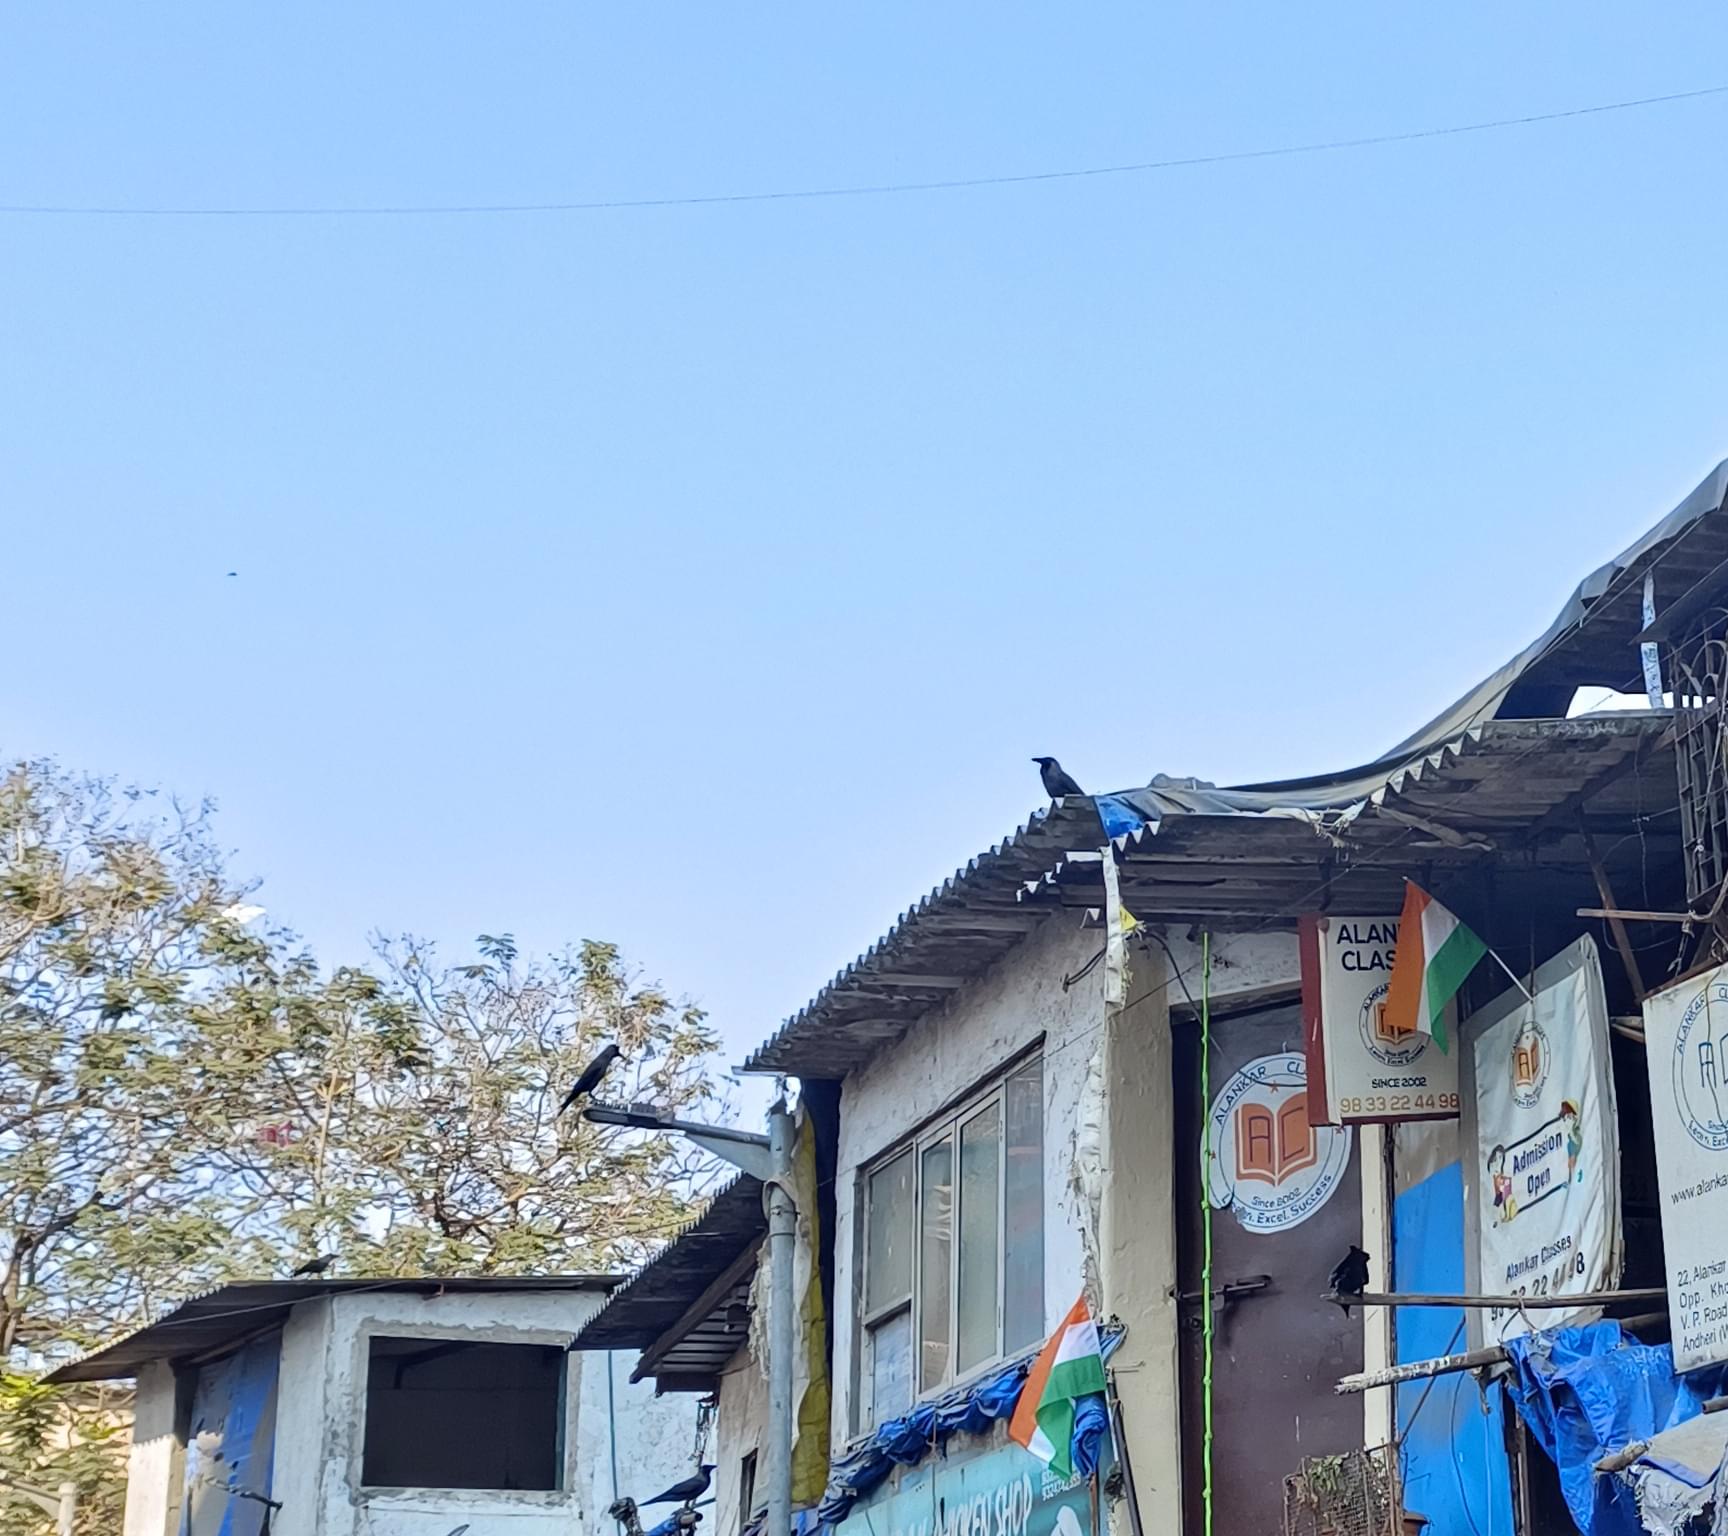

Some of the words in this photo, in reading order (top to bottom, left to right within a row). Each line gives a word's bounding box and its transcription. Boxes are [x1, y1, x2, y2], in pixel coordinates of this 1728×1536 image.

[1337, 923, 1398, 945] ALAN
[1341, 950, 1396, 972] CLAS
[1371, 1077, 1400, 1089] SINCE
[1401, 1076, 1428, 1088] 2002
[1214, 1065, 1267, 1127] ALANKAR
[1340, 1097, 1362, 1113] 98
[1365, 1096, 1387, 1112] 33
[1390, 1095, 1411, 1111] 22
[1414, 1093, 1436, 1109] 44
[1438, 1092, 1460, 1109] 98
[1512, 1131, 1563, 1175] Admission
[1527, 1167, 1551, 1196] Open
[1290, 1174, 1332, 1217] Success
[1505, 1255, 1539, 1284] Alankar
[1677, 1270, 1692, 1287] 22,
[1679, 1291, 1704, 1310] Opp.
[1680, 1315, 1690, 1330] V.
[1692, 1311, 1701, 1327] P.
